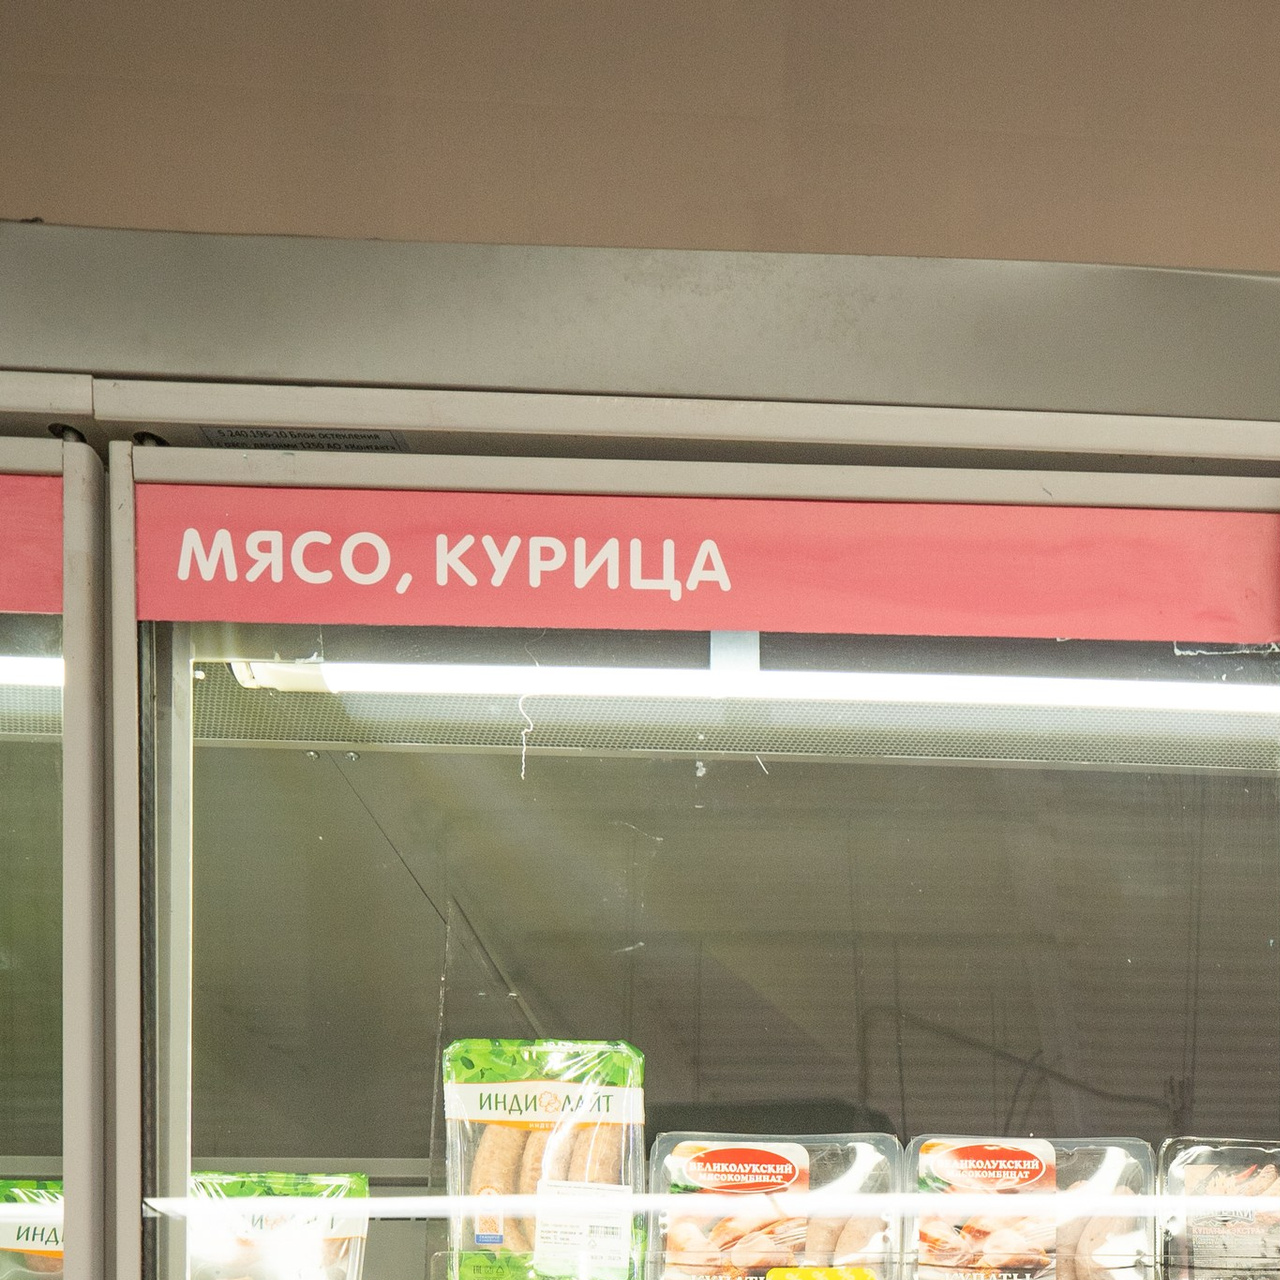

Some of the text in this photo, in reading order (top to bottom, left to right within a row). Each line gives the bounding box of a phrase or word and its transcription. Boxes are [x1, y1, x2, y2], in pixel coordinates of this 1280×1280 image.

[178, 528, 732, 601] МЯСО, КУРИЦА
[689, 1161, 793, 1175] ВЕЛИКОЛУКСКИЙ
[700, 1173, 784, 1184] МЯСОКОМБИНАТ
